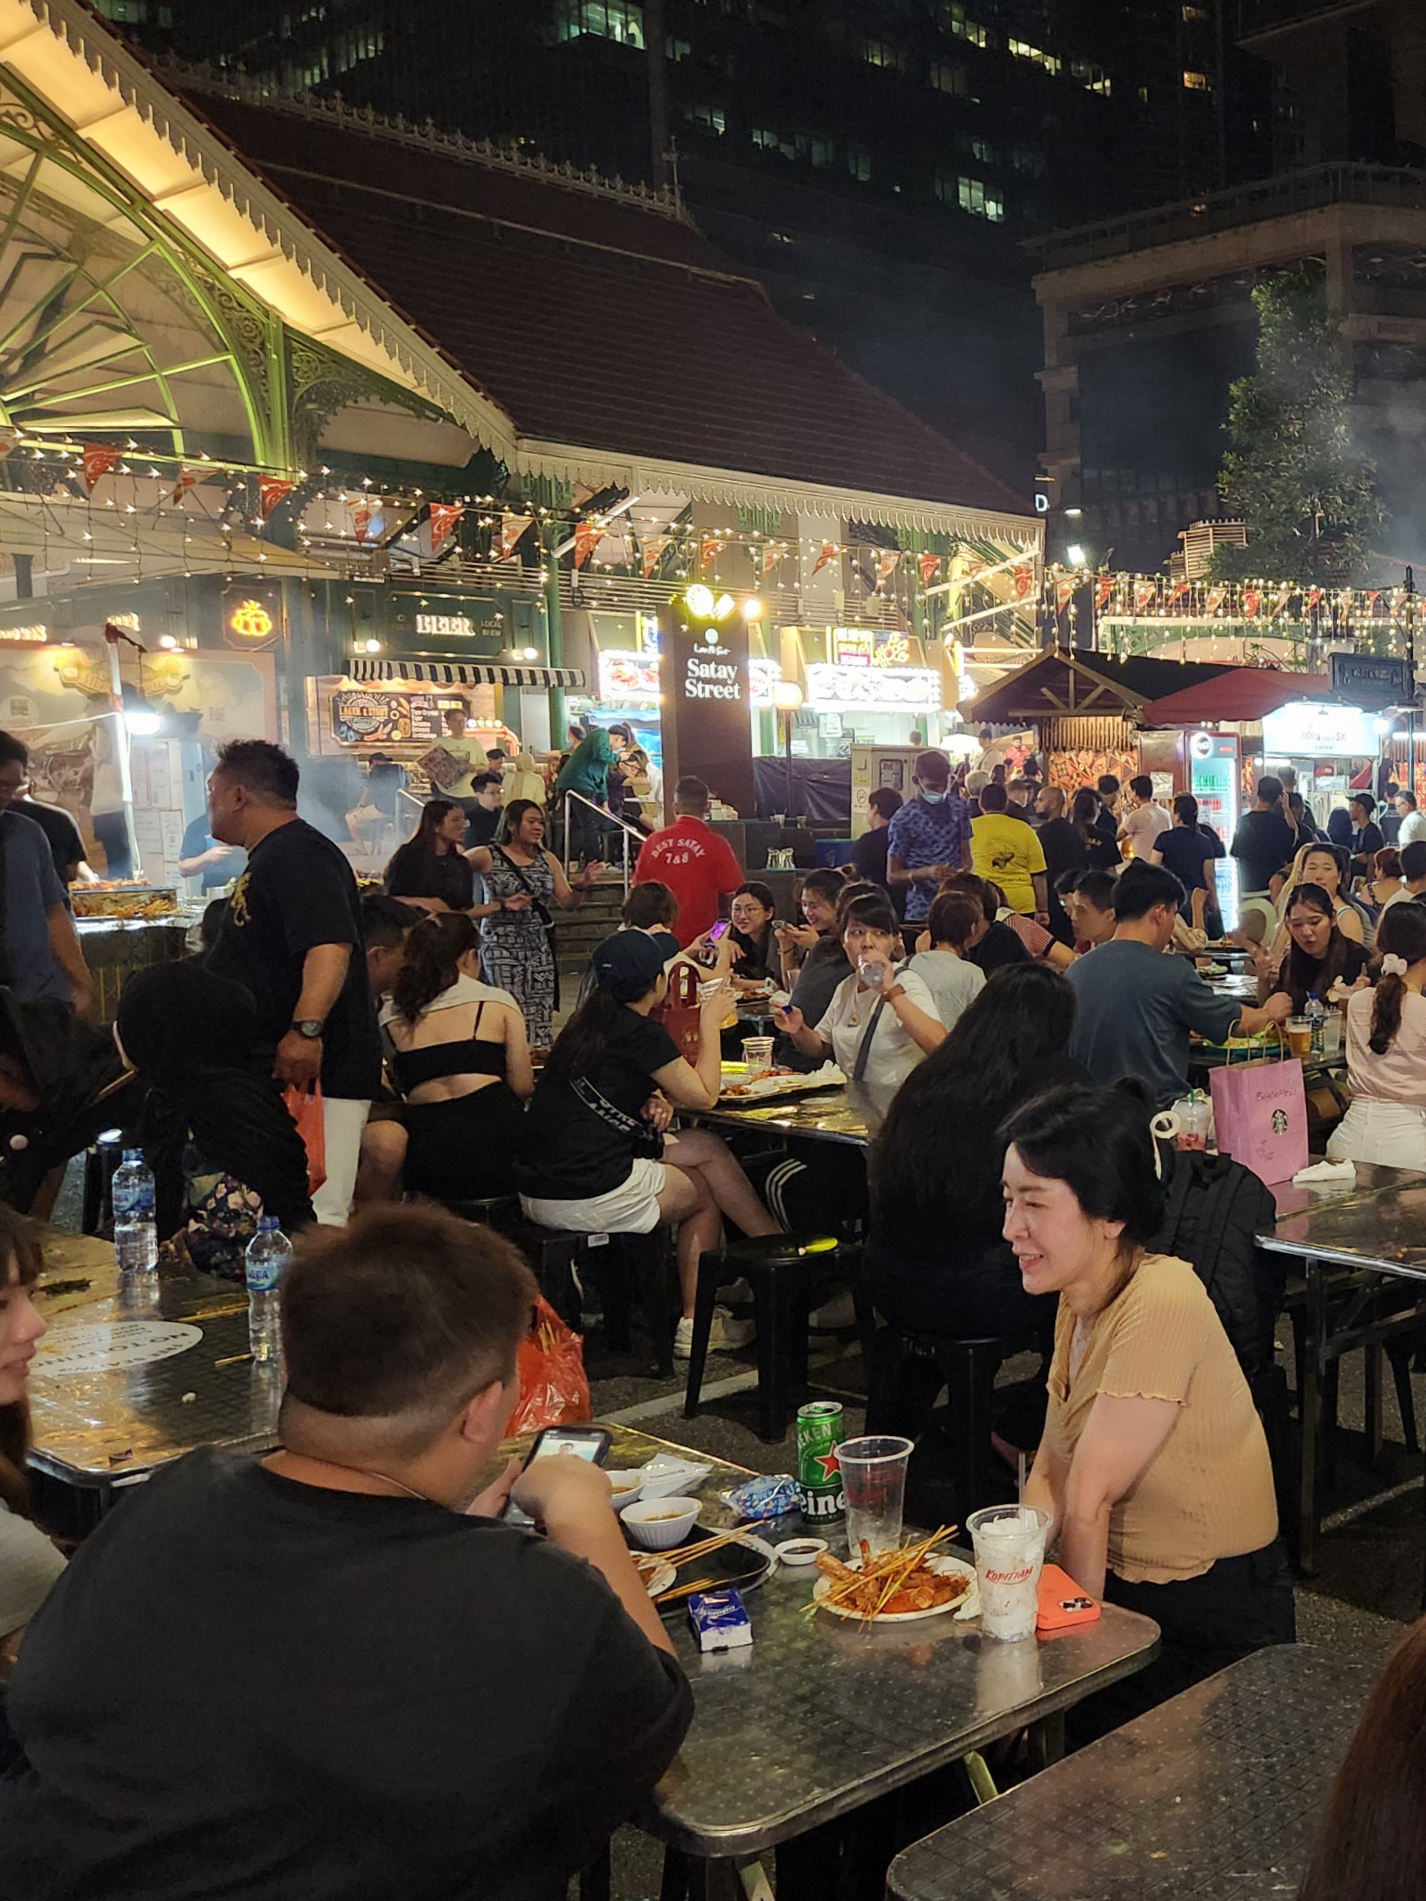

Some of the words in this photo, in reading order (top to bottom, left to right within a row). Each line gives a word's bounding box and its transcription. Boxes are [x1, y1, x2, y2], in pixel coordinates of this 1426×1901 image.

[416, 614, 477, 637] BEER
[481, 620, 502, 628] LOCAL
[687, 657, 738, 684] Satay
[685, 678, 742, 700] Street
[651, 838, 674, 858] BEST
[677, 838, 706, 858] SATAY
[665, 852, 689, 864] 7&8
[149, 1331, 191, 1343] NO
[985, 1565, 1034, 1582] KOPITIAM
